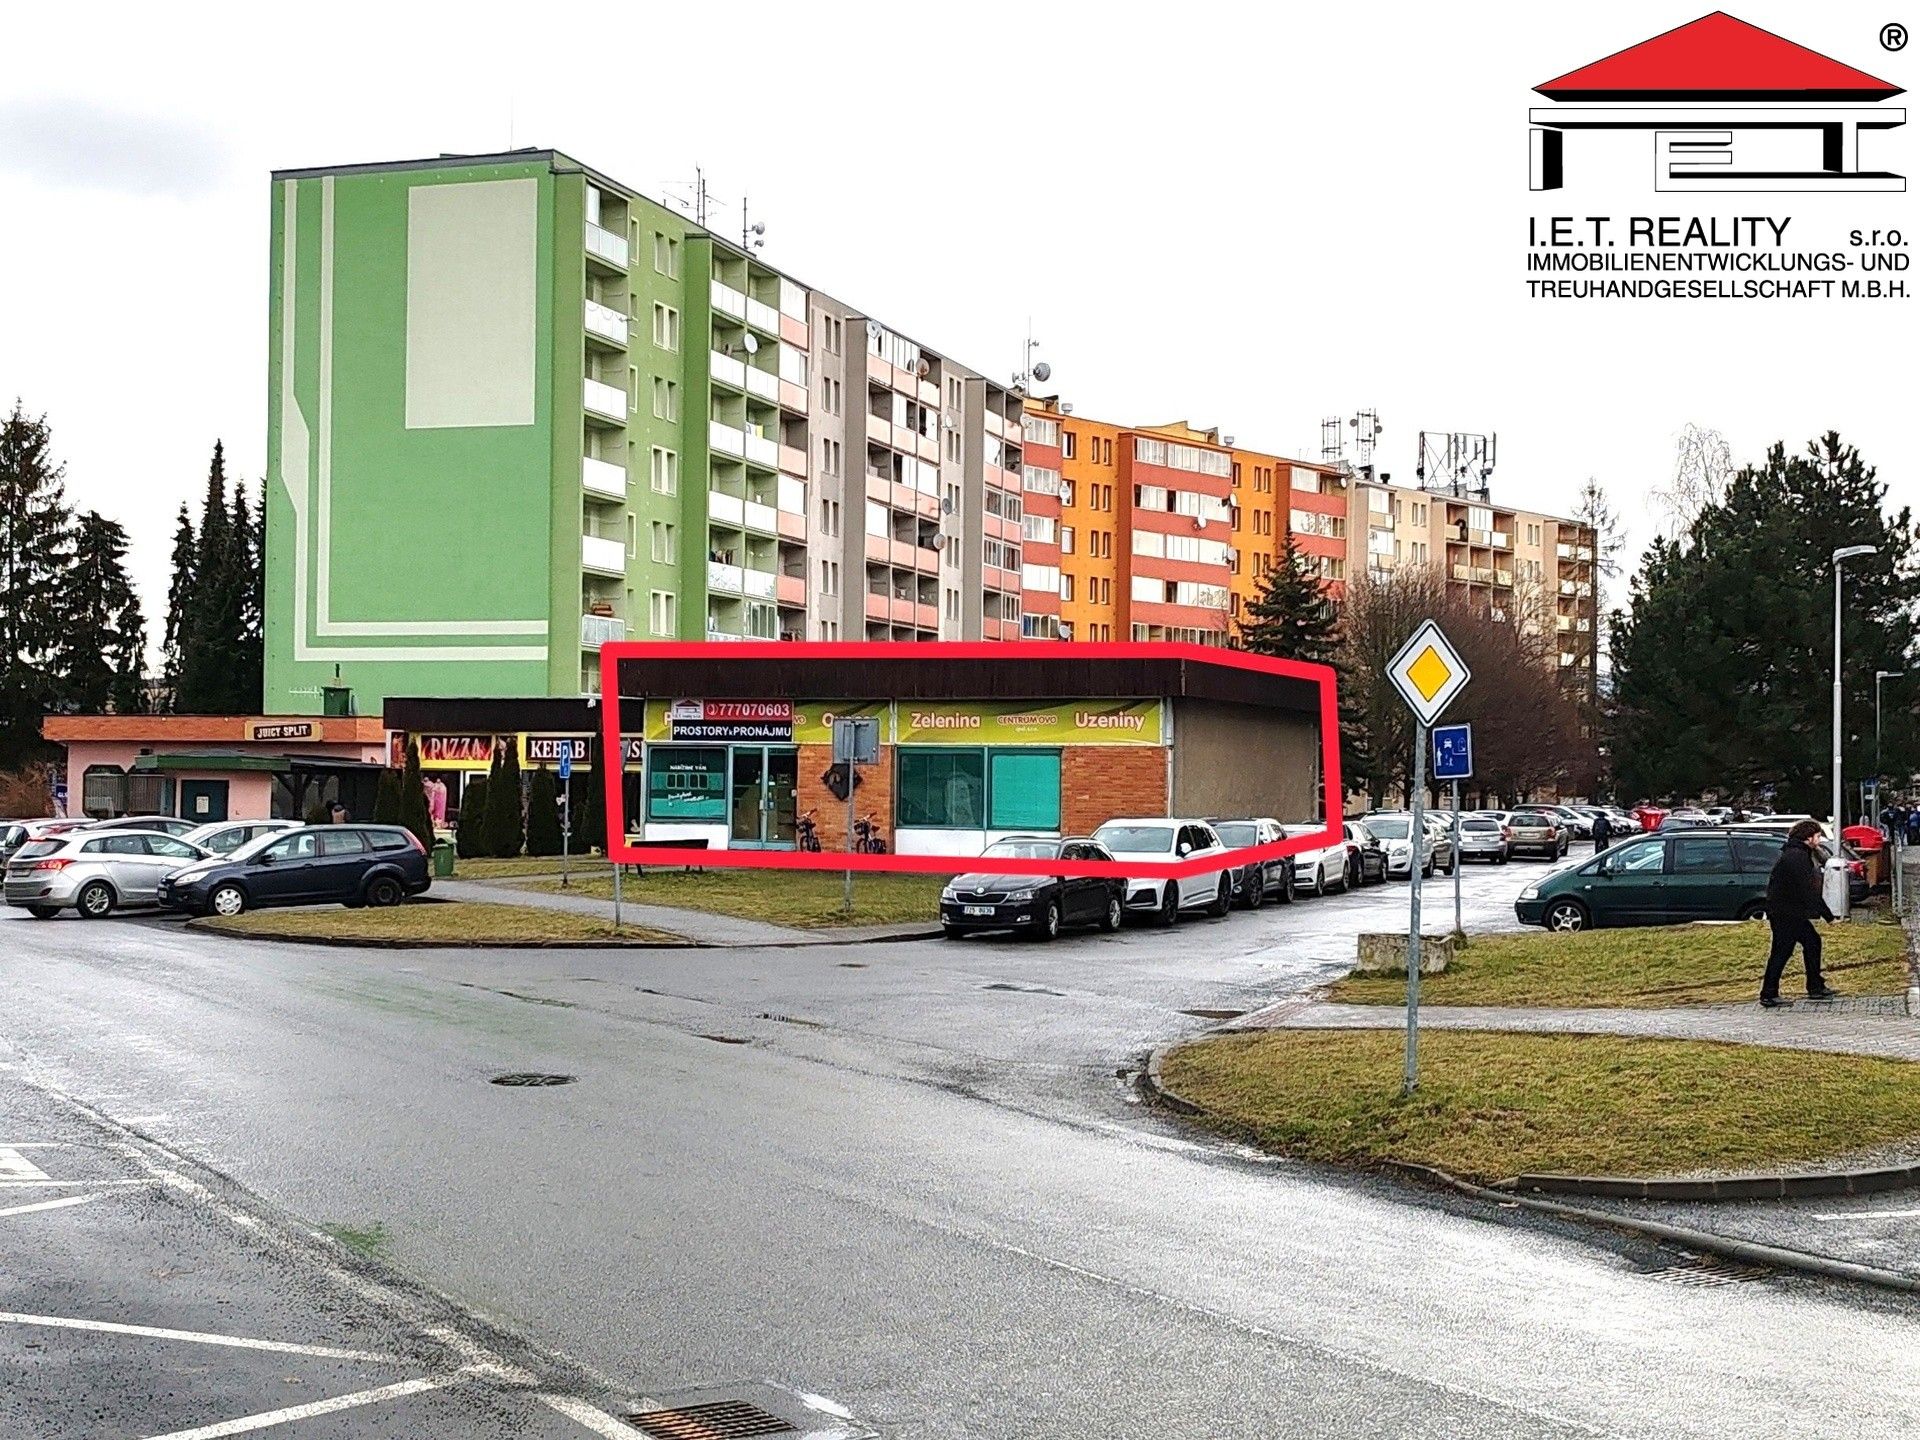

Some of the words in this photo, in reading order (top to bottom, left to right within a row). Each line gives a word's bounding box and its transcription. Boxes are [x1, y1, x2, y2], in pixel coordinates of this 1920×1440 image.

[719, 703, 790, 716] 777070603
[911, 712, 981, 728] Zelenina
[998, 715, 1038, 725] CENTRUM
[1074, 711, 1145, 732] Uzeniny
[257, 727, 281, 739] JUICY
[283, 725, 308, 737] SPLIT
[673, 726, 729, 736] PROSTORY
[733, 725, 792, 736] PRONÁJMU
[430, 737, 482, 760] PIZZA
